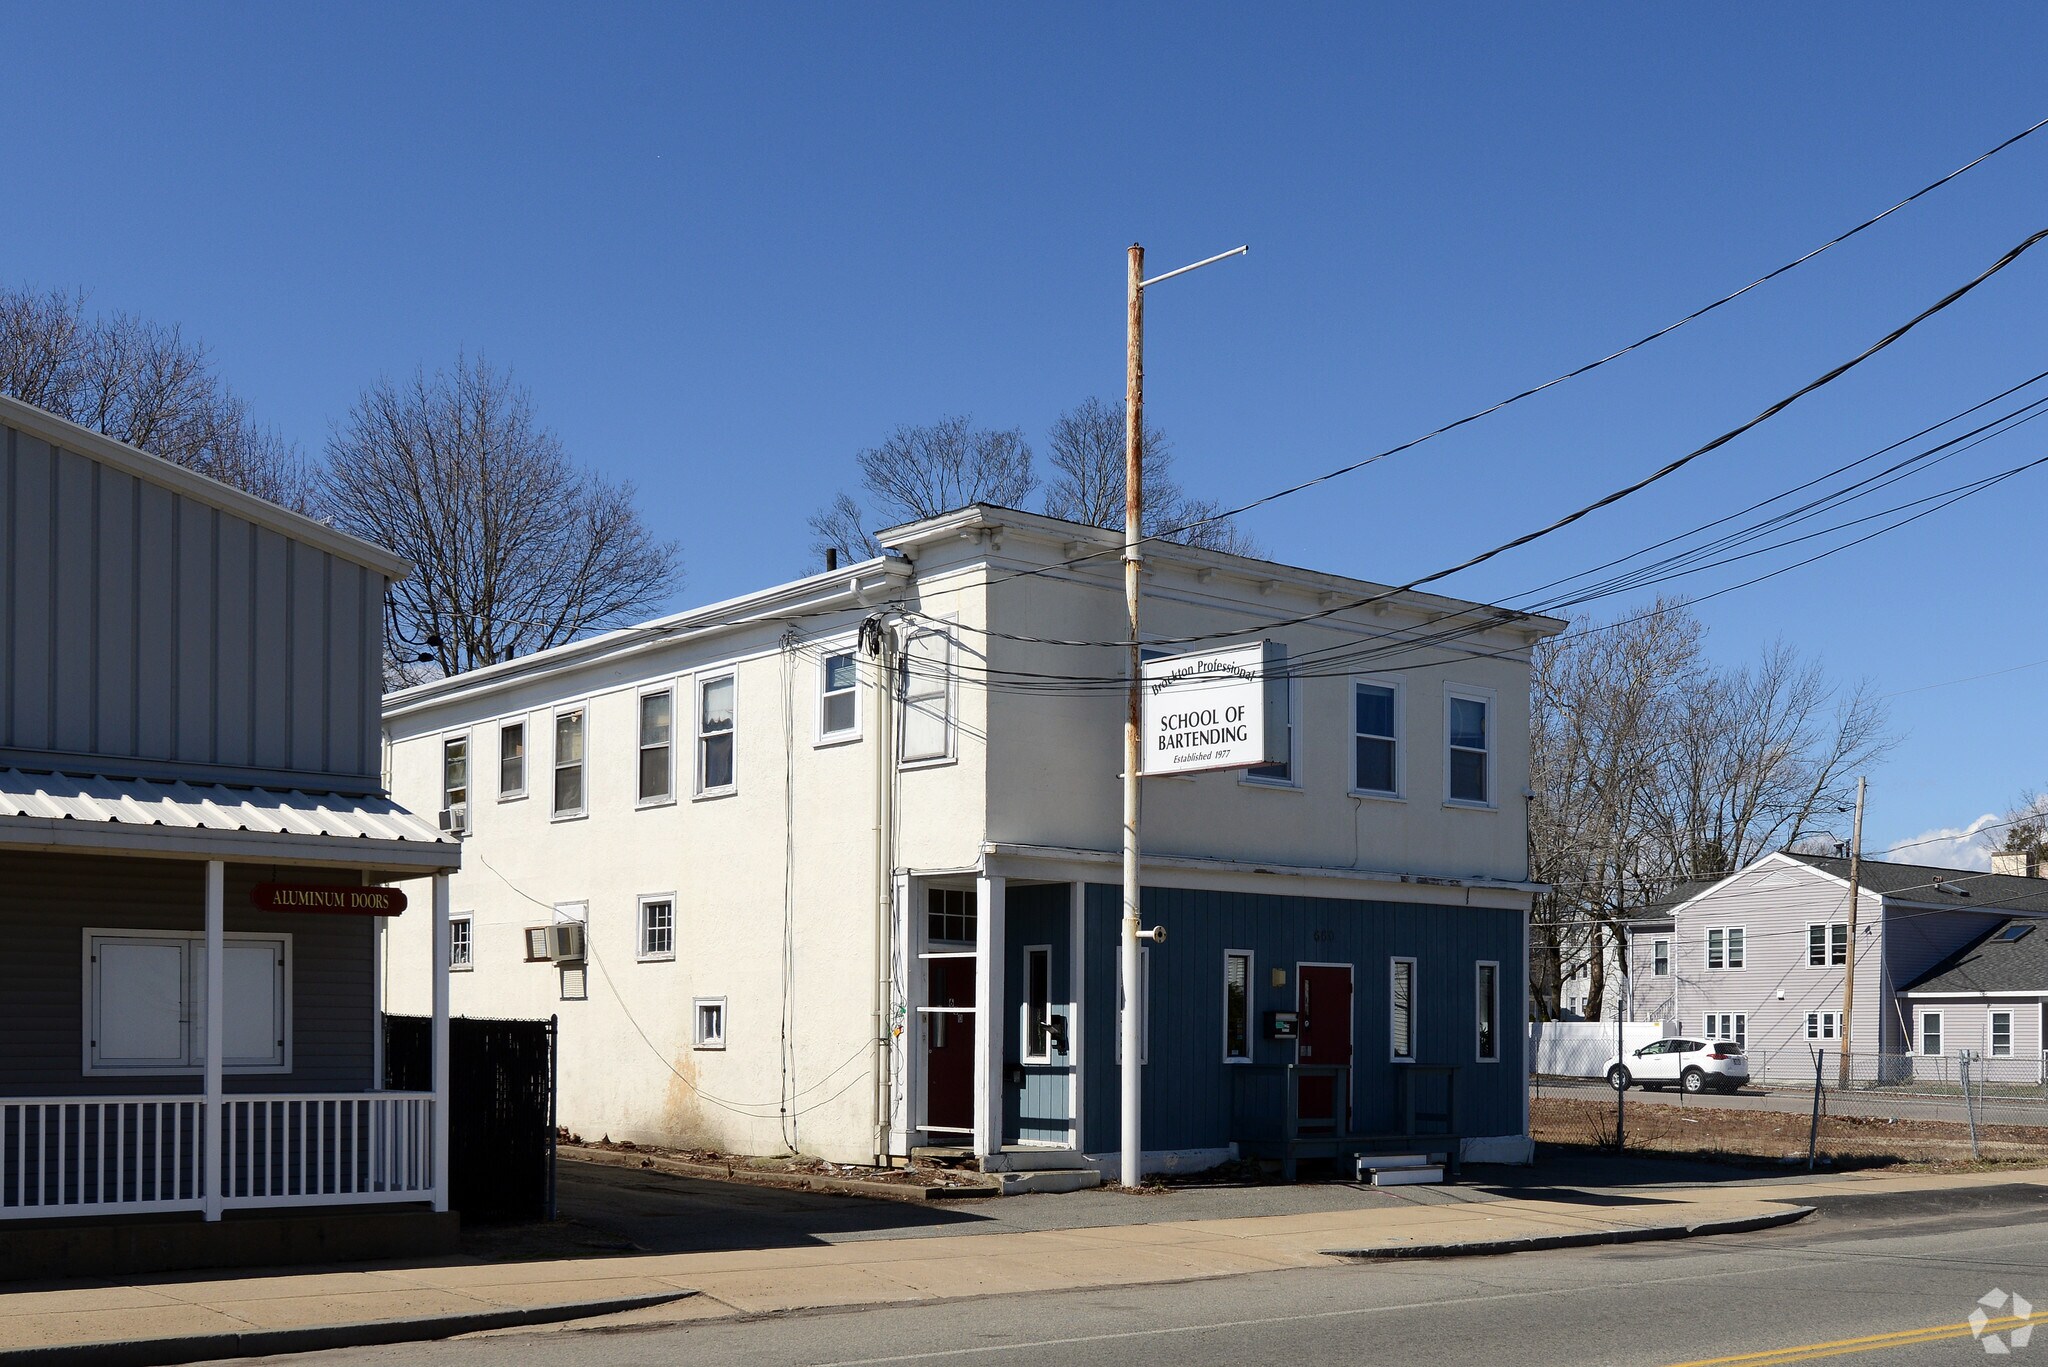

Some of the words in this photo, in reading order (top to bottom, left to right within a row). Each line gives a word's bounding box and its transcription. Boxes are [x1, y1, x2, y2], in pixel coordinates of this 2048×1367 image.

[1152, 665, 1194, 696] Brockton
[1197, 658, 1256, 682] Professional
[1161, 709, 1219, 732] SCHOOL
[1225, 705, 1245, 723] OF
[1158, 724, 1248, 751] BARTENDING
[1173, 751, 1212, 764] Established
[1215, 749, 1231, 759] 1977
[272, 890, 345, 907] ALUMINUM
[351, 893, 389, 909] DOORS
